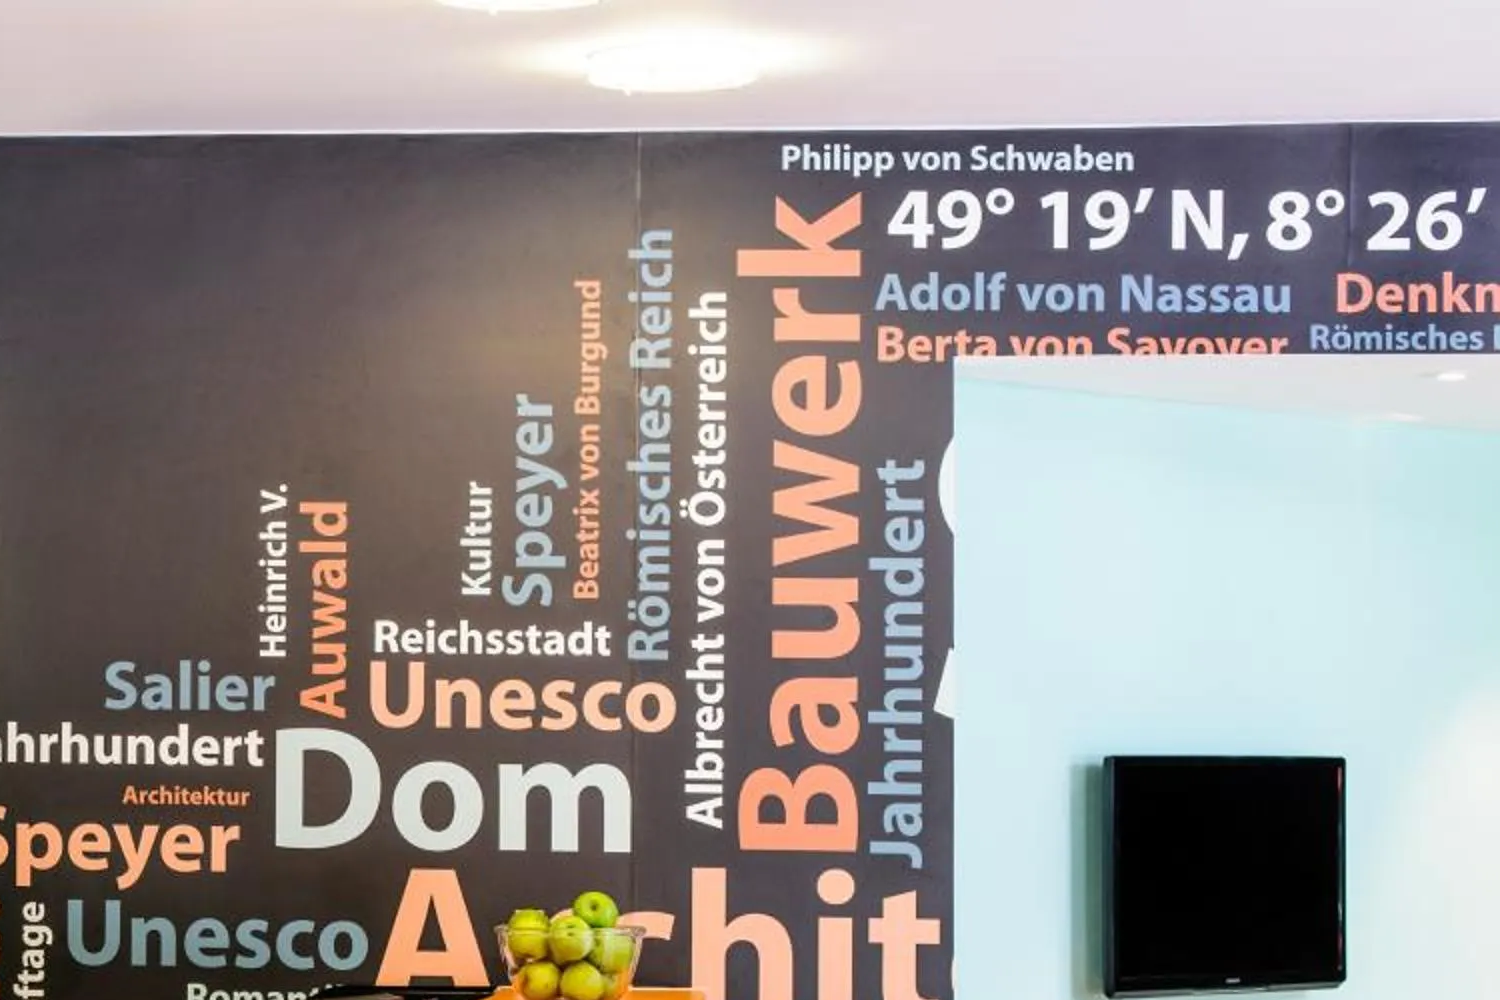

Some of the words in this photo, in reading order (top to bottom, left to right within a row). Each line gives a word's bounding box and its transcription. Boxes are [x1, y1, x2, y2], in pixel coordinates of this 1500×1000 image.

[782, 144, 894, 177] Philipp
[902, 152, 960, 170] von
[971, 144, 1134, 171] Schwaben
[888, 188, 1014, 249] 49°
[628, 231, 672, 368] Reich
[875, 272, 1006, 310] Adolf
[1017, 284, 1104, 312] von
[1121, 275, 1290, 313] Nassau
[1310, 324, 1484, 350] Römisches
[574, 281, 608, 414] Burgund
[877, 325, 997, 362] Berta
[1009, 335, 1093, 356] von
[580, 425, 600, 481] von
[680, 293, 727, 526] Österreich
[259, 483, 288, 513] V.
[460, 481, 492, 595] Kultur
[502, 393, 567, 605] Speyer
[573, 489, 599, 598] Beatrix
[627, 385, 672, 660] Römisches
[737, 193, 861, 851] Bauwerk
[258, 521, 287, 656] Heinrich
[299, 502, 347, 718] Auwald
[697, 540, 724, 622] von
[375, 620, 611, 656] Reichsstadt
[868, 460, 924, 868] Jahrhundert
[105, 661, 275, 711] Salier
[370, 661, 676, 732] Unesco
[685, 634, 724, 828] Albrecht
[123, 786, 250, 805] Architektur
[275, 727, 632, 853] Dom
[68, 900, 368, 970] Unesco
